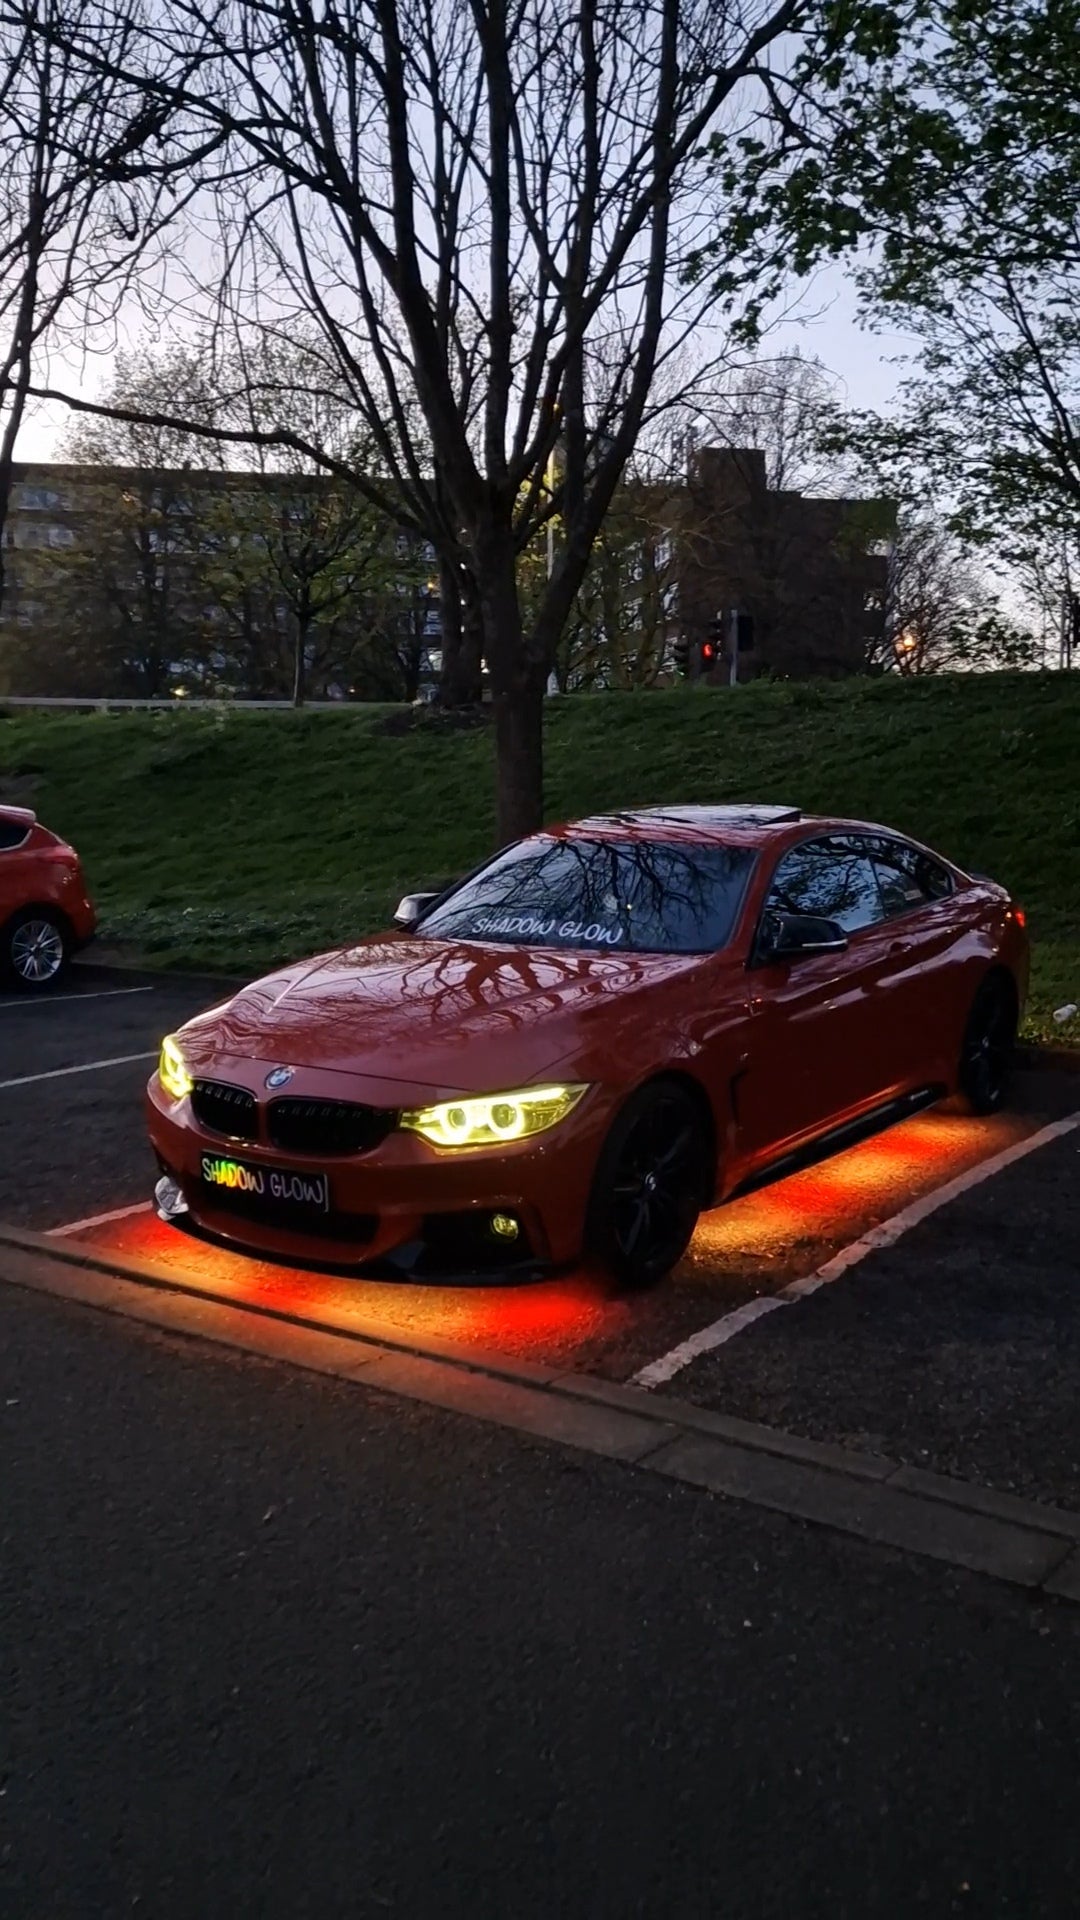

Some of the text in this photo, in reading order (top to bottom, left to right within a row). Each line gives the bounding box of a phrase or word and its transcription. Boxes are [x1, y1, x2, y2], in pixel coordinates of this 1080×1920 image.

[472, 917, 623, 944] SHADOW GLOW
[202, 1157, 323, 1204] SHADOW GLOW
